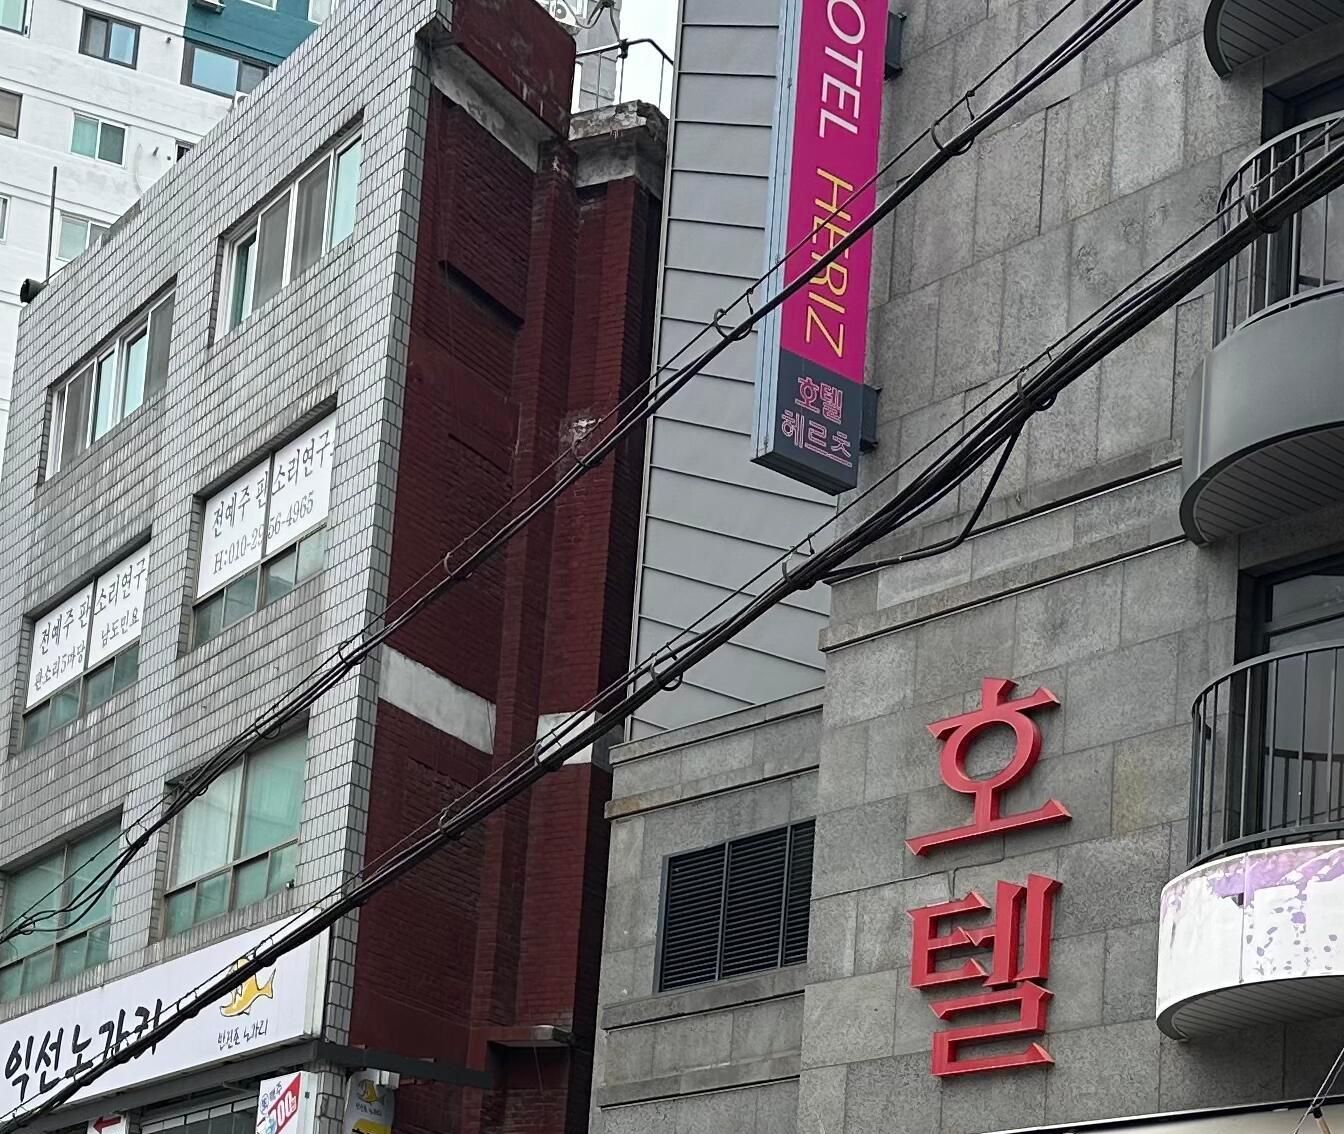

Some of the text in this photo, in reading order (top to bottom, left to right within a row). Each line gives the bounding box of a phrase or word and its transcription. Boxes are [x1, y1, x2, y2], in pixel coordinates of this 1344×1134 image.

[794, 374, 844, 425] 호텔
[254, 429, 334, 508] 판소리연구
[780, 410, 854, 468] 헤르츠
[77, 556, 149, 630] 판소리연구
[100, 606, 140, 648] 남도민요
[904, 677, 1073, 1076] 호텔
[4, 997, 163, 1102] 익선노가리
